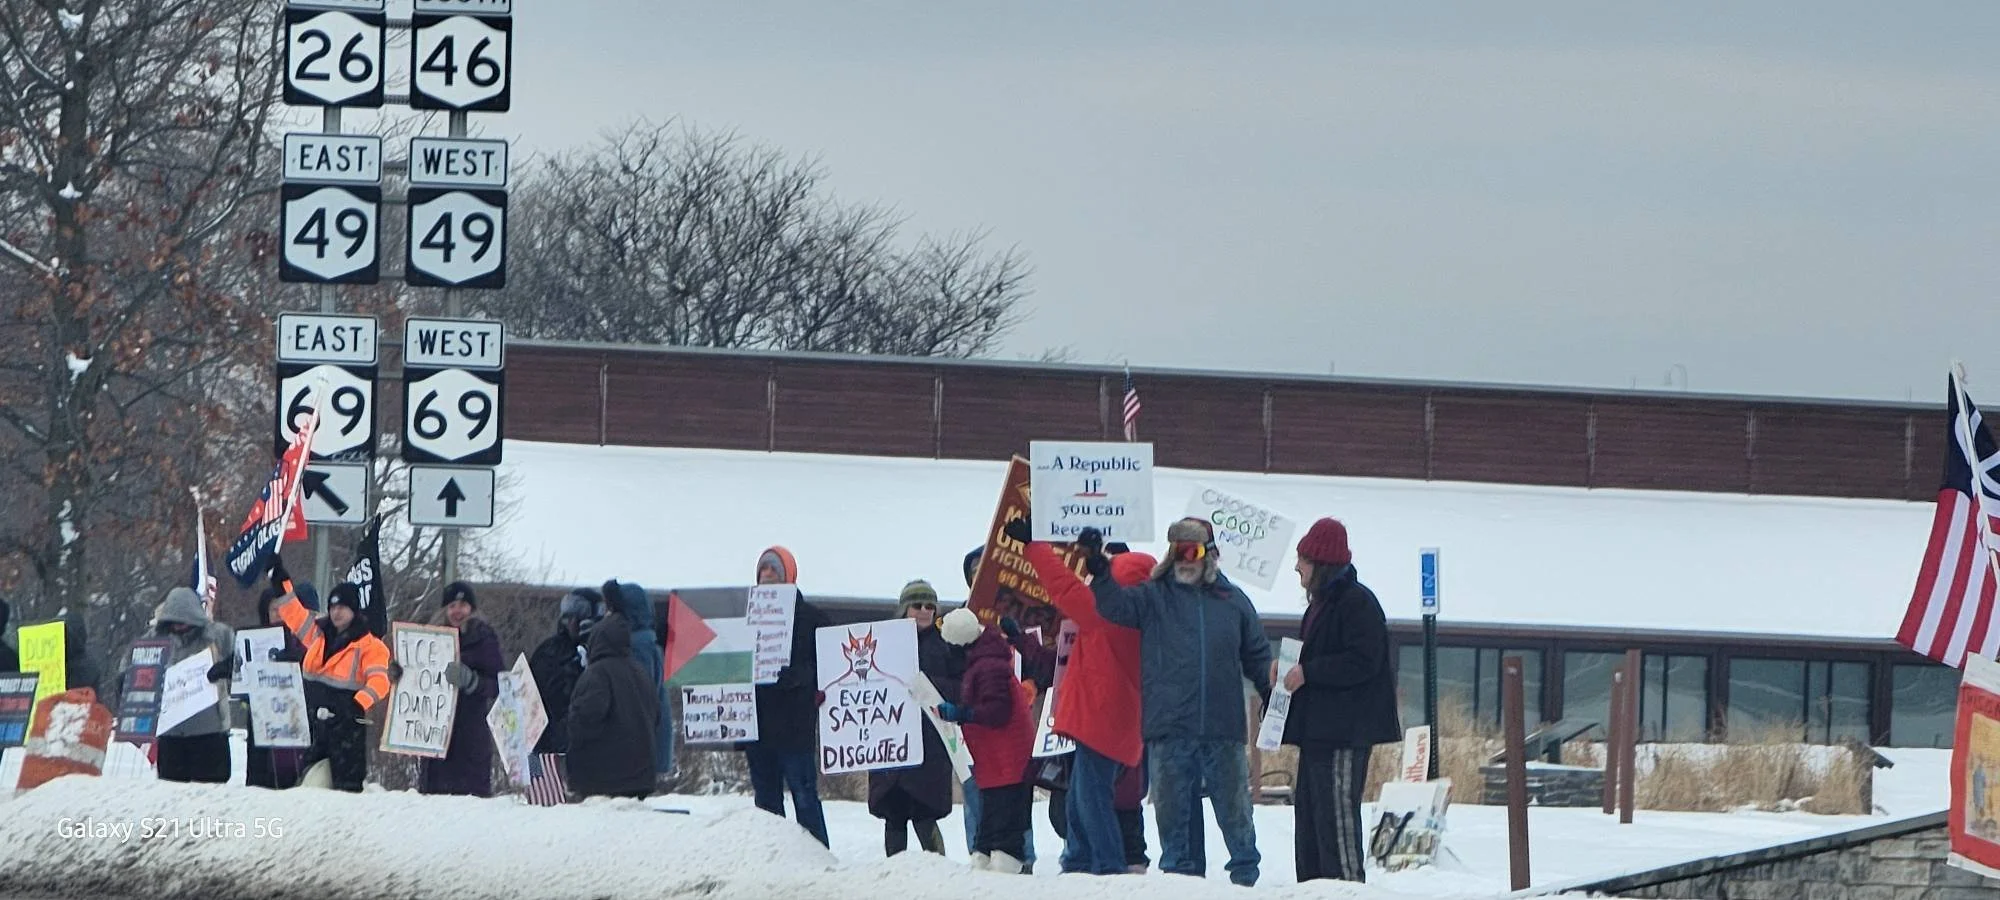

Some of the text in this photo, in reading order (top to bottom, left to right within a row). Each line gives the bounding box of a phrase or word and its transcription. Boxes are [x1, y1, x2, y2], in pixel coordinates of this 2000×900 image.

[295, 28, 373, 84] 26
[420, 35, 501, 88] 46
[301, 144, 367, 172] EAST
[423, 148, 495, 176] WEST
[293, 207, 368, 259] 49
[419, 211, 495, 263] 49
[295, 325, 363, 352] EAST
[419, 329, 491, 357] WEST
[287, 385, 365, 437] 69
[413, 389, 492, 441] 69
[1070, 456, 1141, 474] Republic
[1085, 478, 1102, 493] IF
[1060, 504, 1124, 518] you can
[1202, 489, 1283, 530] CHOOSE
[1051, 522, 1083, 536] kee
[1211, 510, 1264, 540] GOOD
[1219, 530, 1254, 548] NOT
[230, 537, 257, 576] FIGHT
[1237, 551, 1273, 577] ICE
[401, 639, 436, 667] ICE
[399, 691, 446, 721] DUMP
[840, 687, 888, 707] EVEN
[829, 701, 905, 732] SATAN
[720, 724, 746, 739] DEAD
[859, 727, 869, 741] IS
